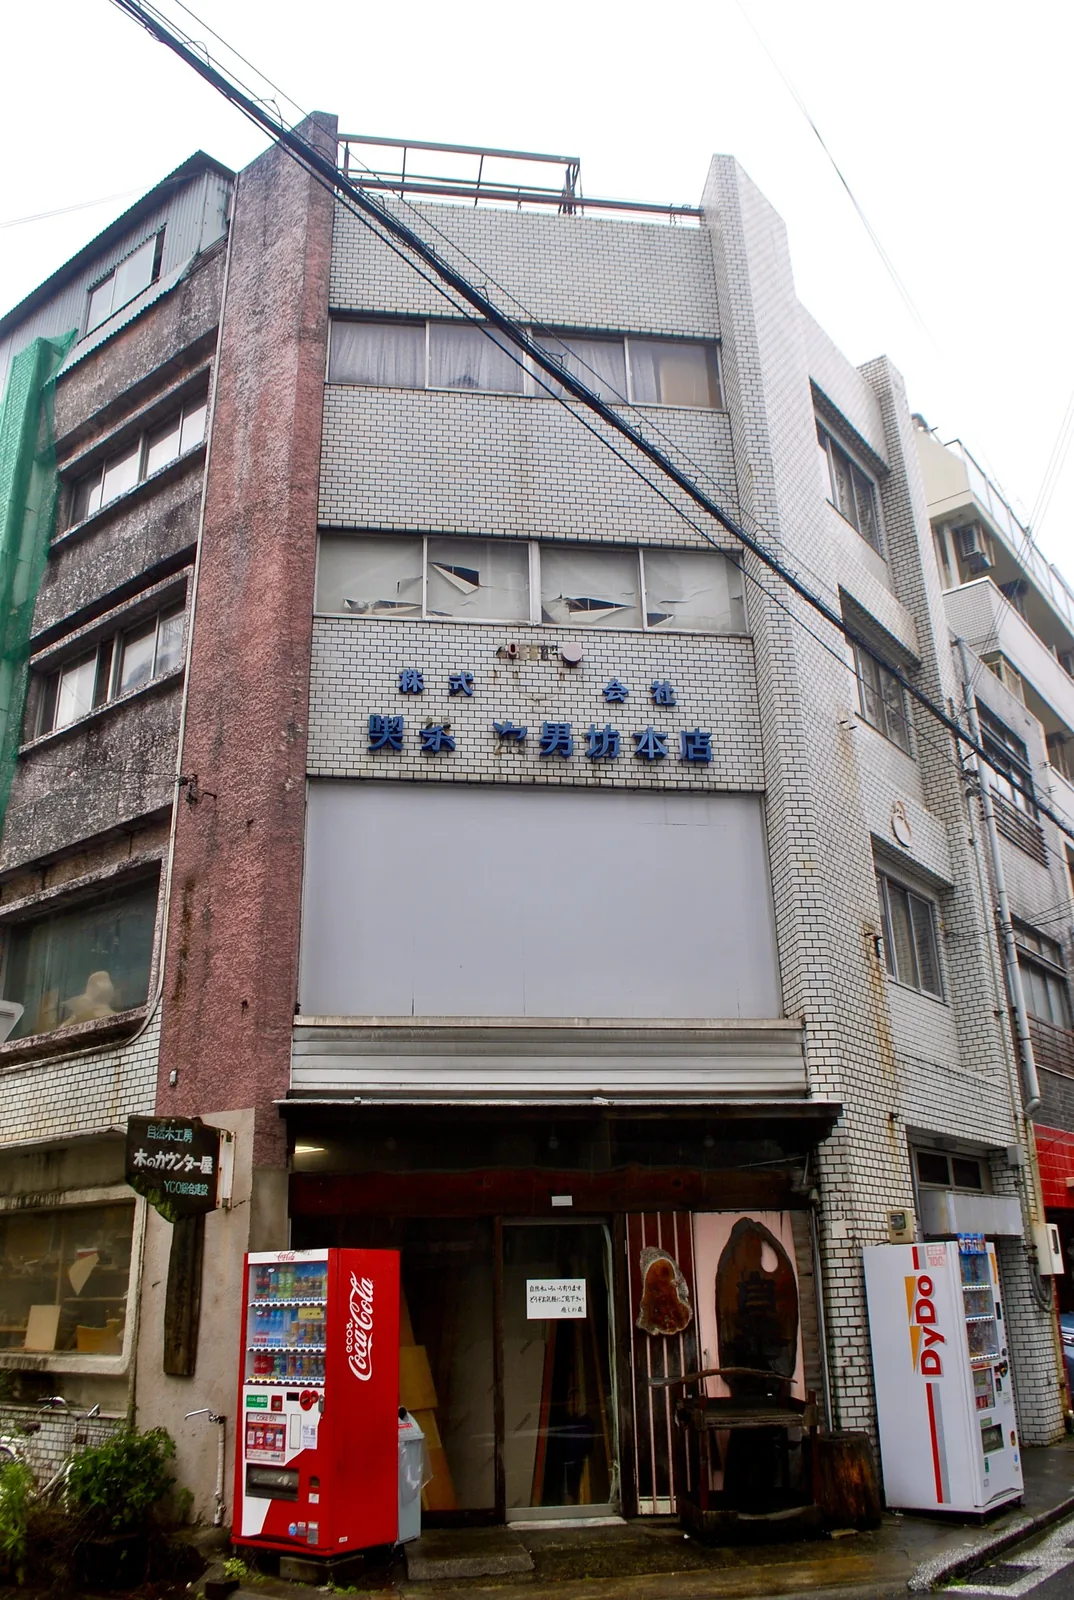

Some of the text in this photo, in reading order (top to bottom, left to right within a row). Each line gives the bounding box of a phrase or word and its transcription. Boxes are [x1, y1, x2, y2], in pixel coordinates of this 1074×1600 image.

[133, 1148, 213, 1175] 木のカウンター屋
[915, 1274, 945, 1375] DyDo
